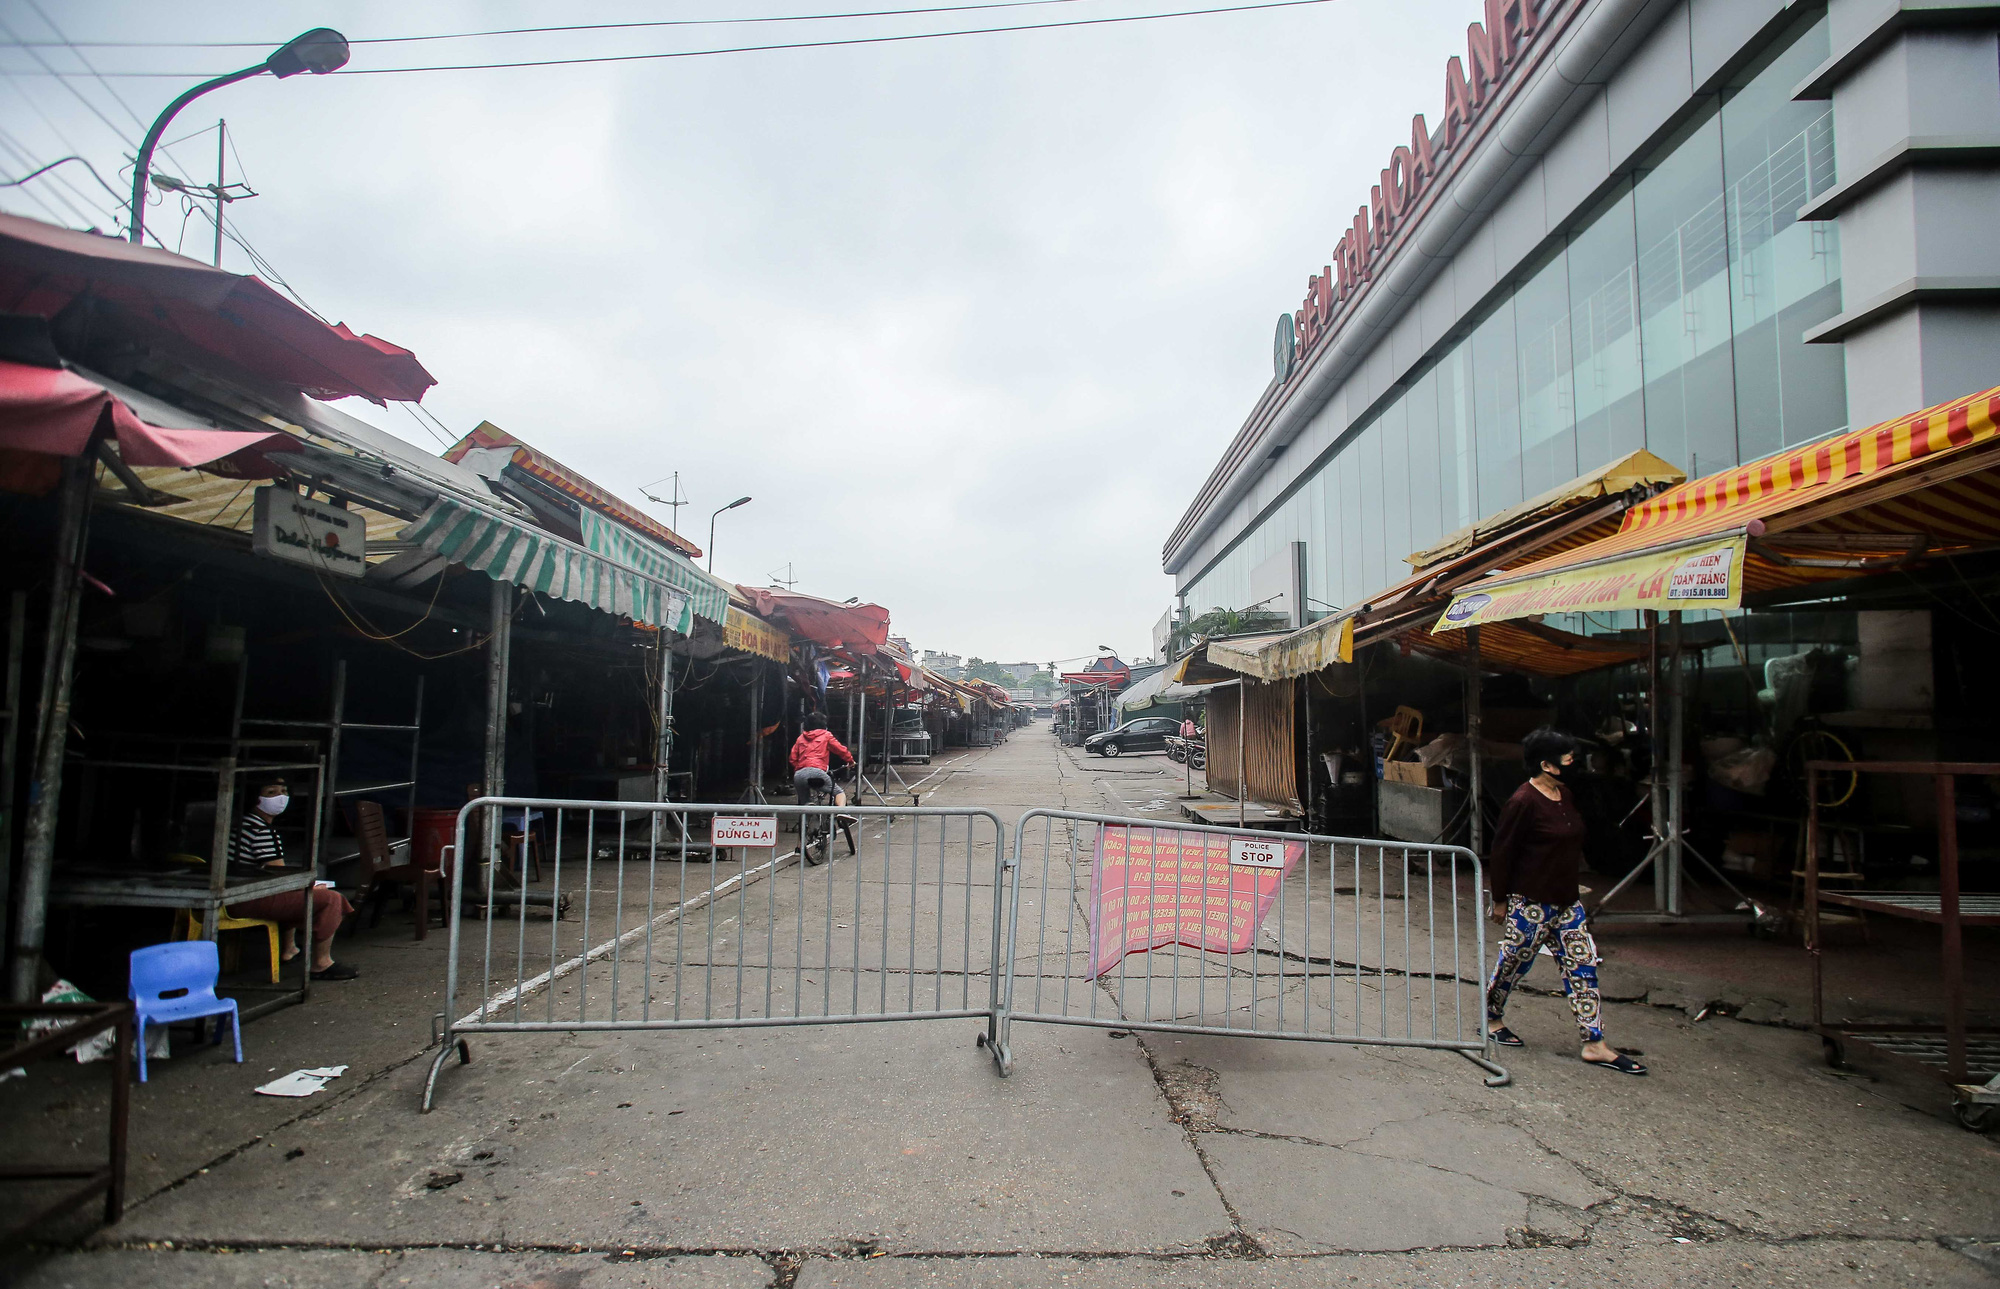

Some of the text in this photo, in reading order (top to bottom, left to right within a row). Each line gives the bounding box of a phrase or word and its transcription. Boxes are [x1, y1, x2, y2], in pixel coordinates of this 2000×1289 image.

[717, 827, 773, 841] DỪNG LẠI
[1241, 851, 1273, 862] STOP
